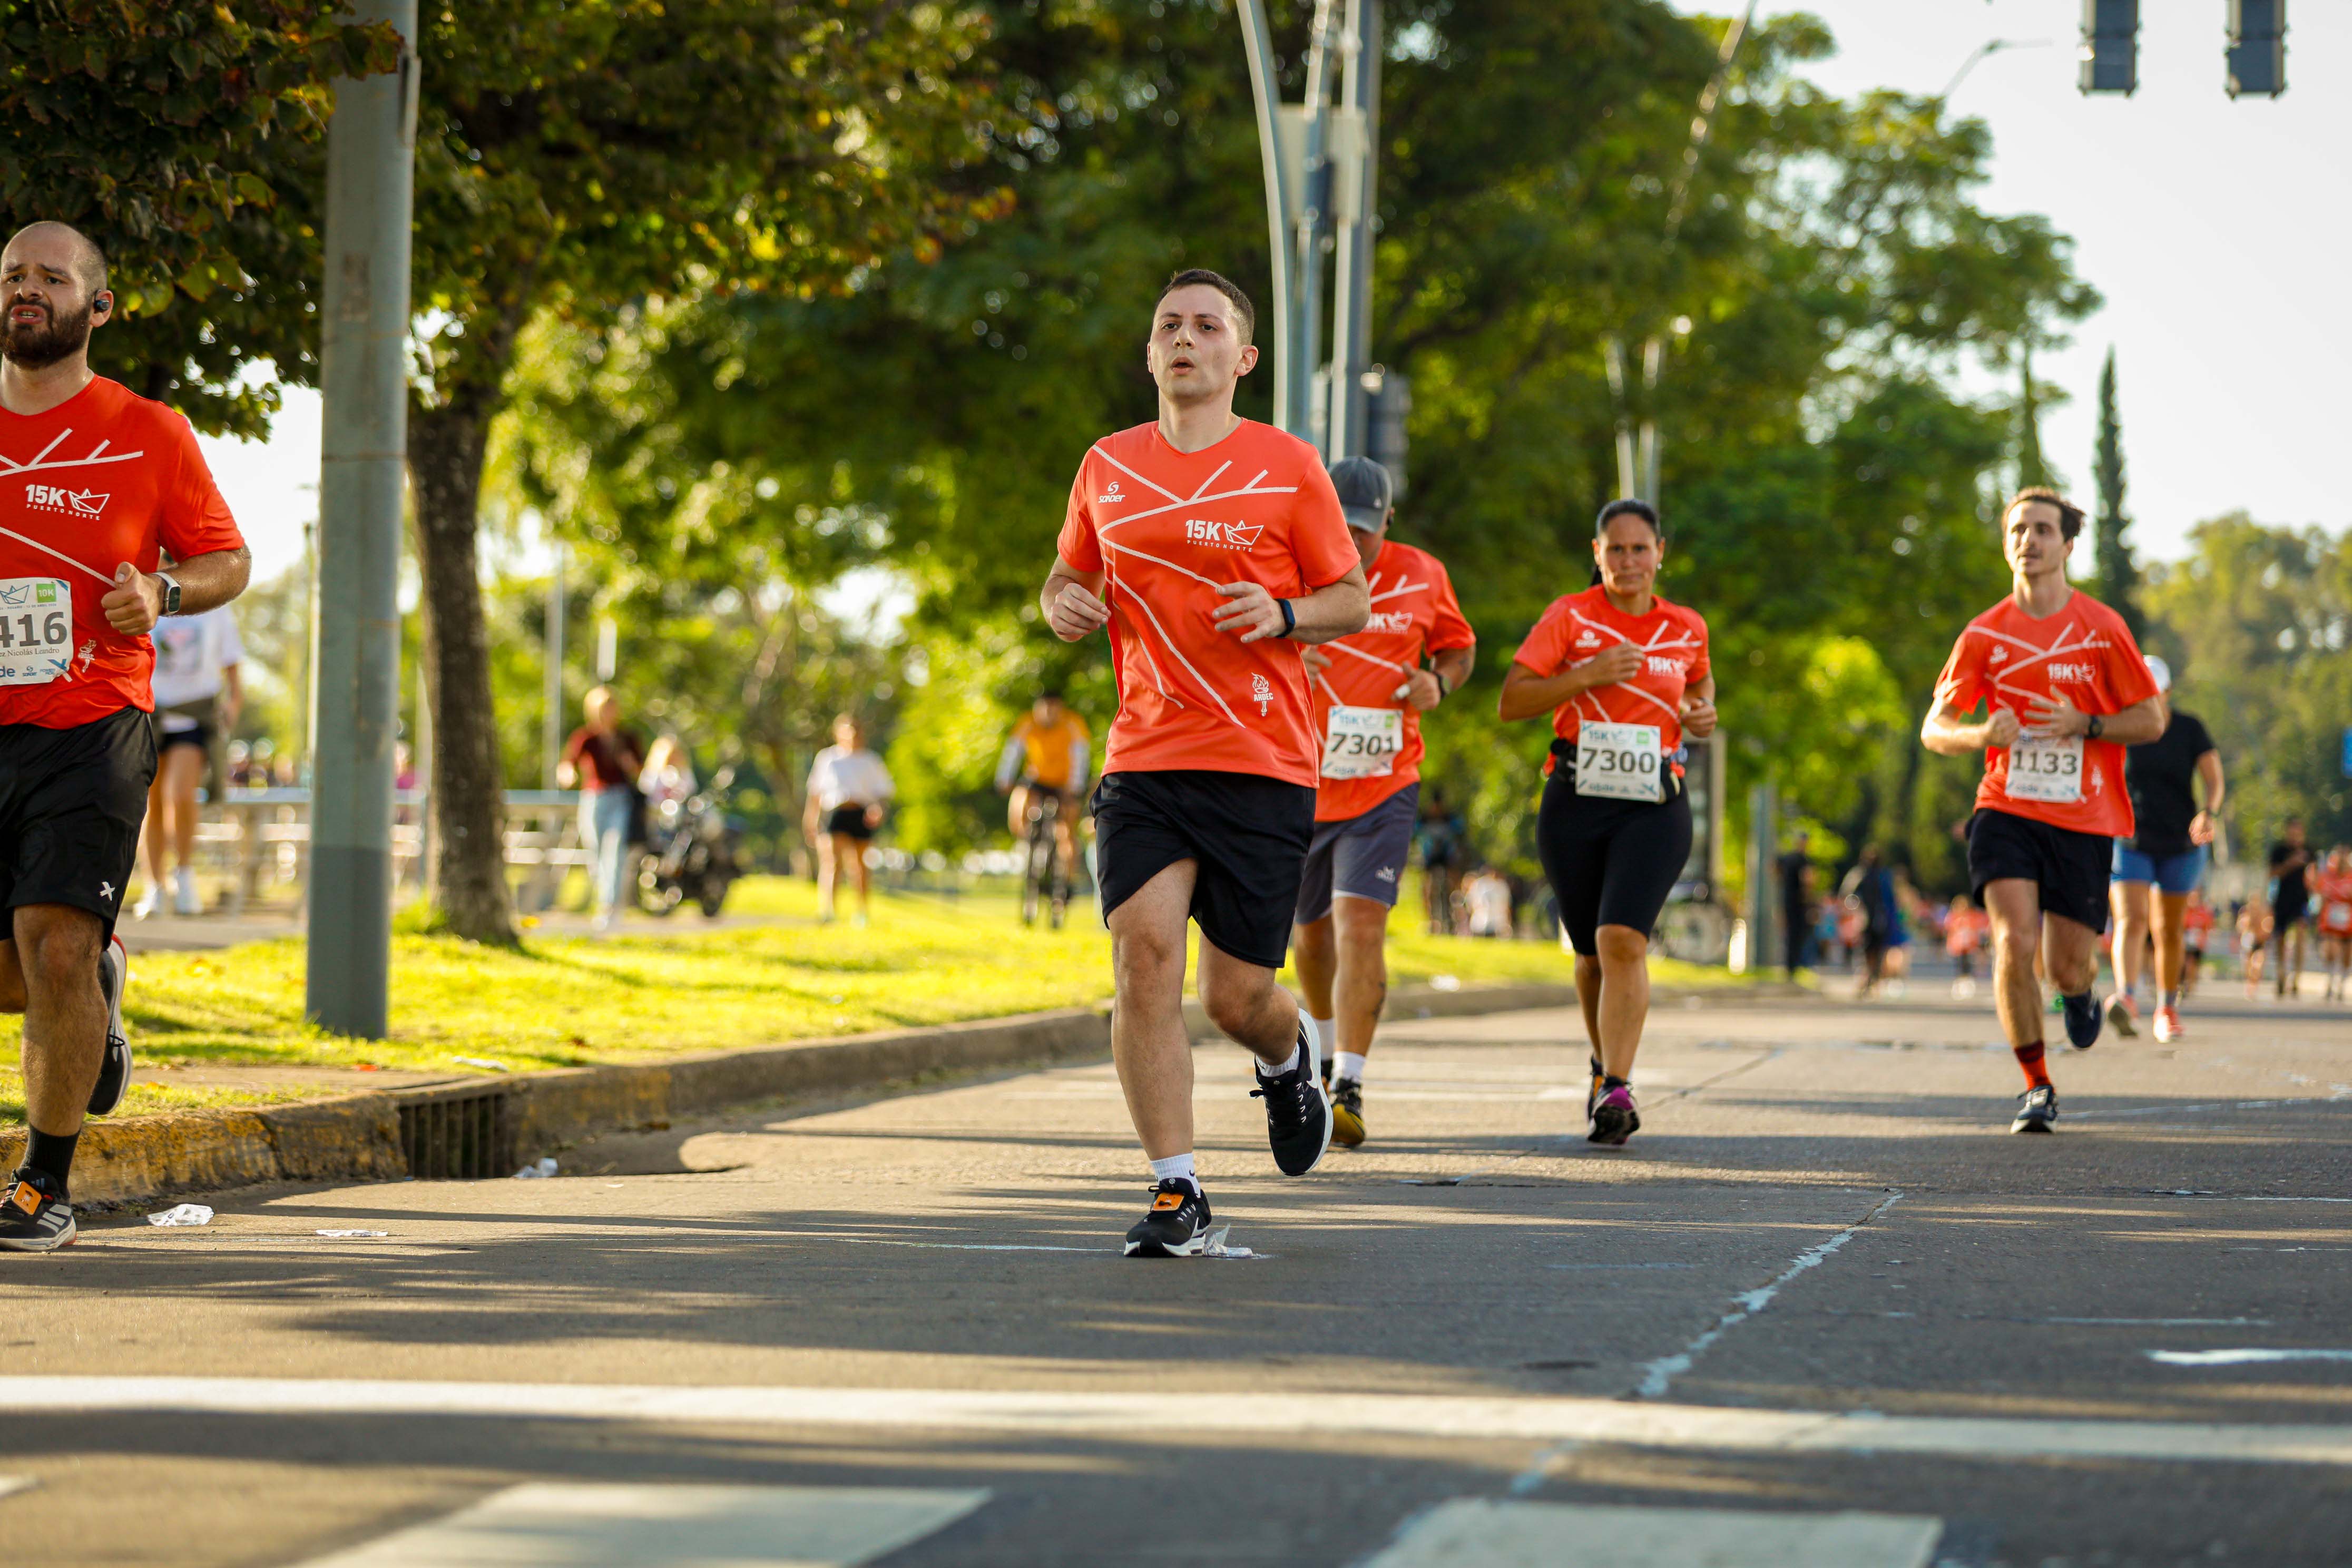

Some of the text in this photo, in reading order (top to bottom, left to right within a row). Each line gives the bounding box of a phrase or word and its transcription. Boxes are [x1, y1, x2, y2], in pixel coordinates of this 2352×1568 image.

[25, 484, 67, 506] 15K
[26, 504, 100, 521] PUERTO NORTE
[1185, 520, 1222, 541] 15K
[1187, 540, 1252, 552] PUERTO NORTE
[7, 648, 33, 657] Nicolás
[2048, 663, 2074, 680] 15K
[1253, 692, 1273, 702] ARDEC
[1331, 732, 1394, 756] 7301
[1582, 747, 1655, 773] 7300
[2013, 749, 2077, 776] 1133
